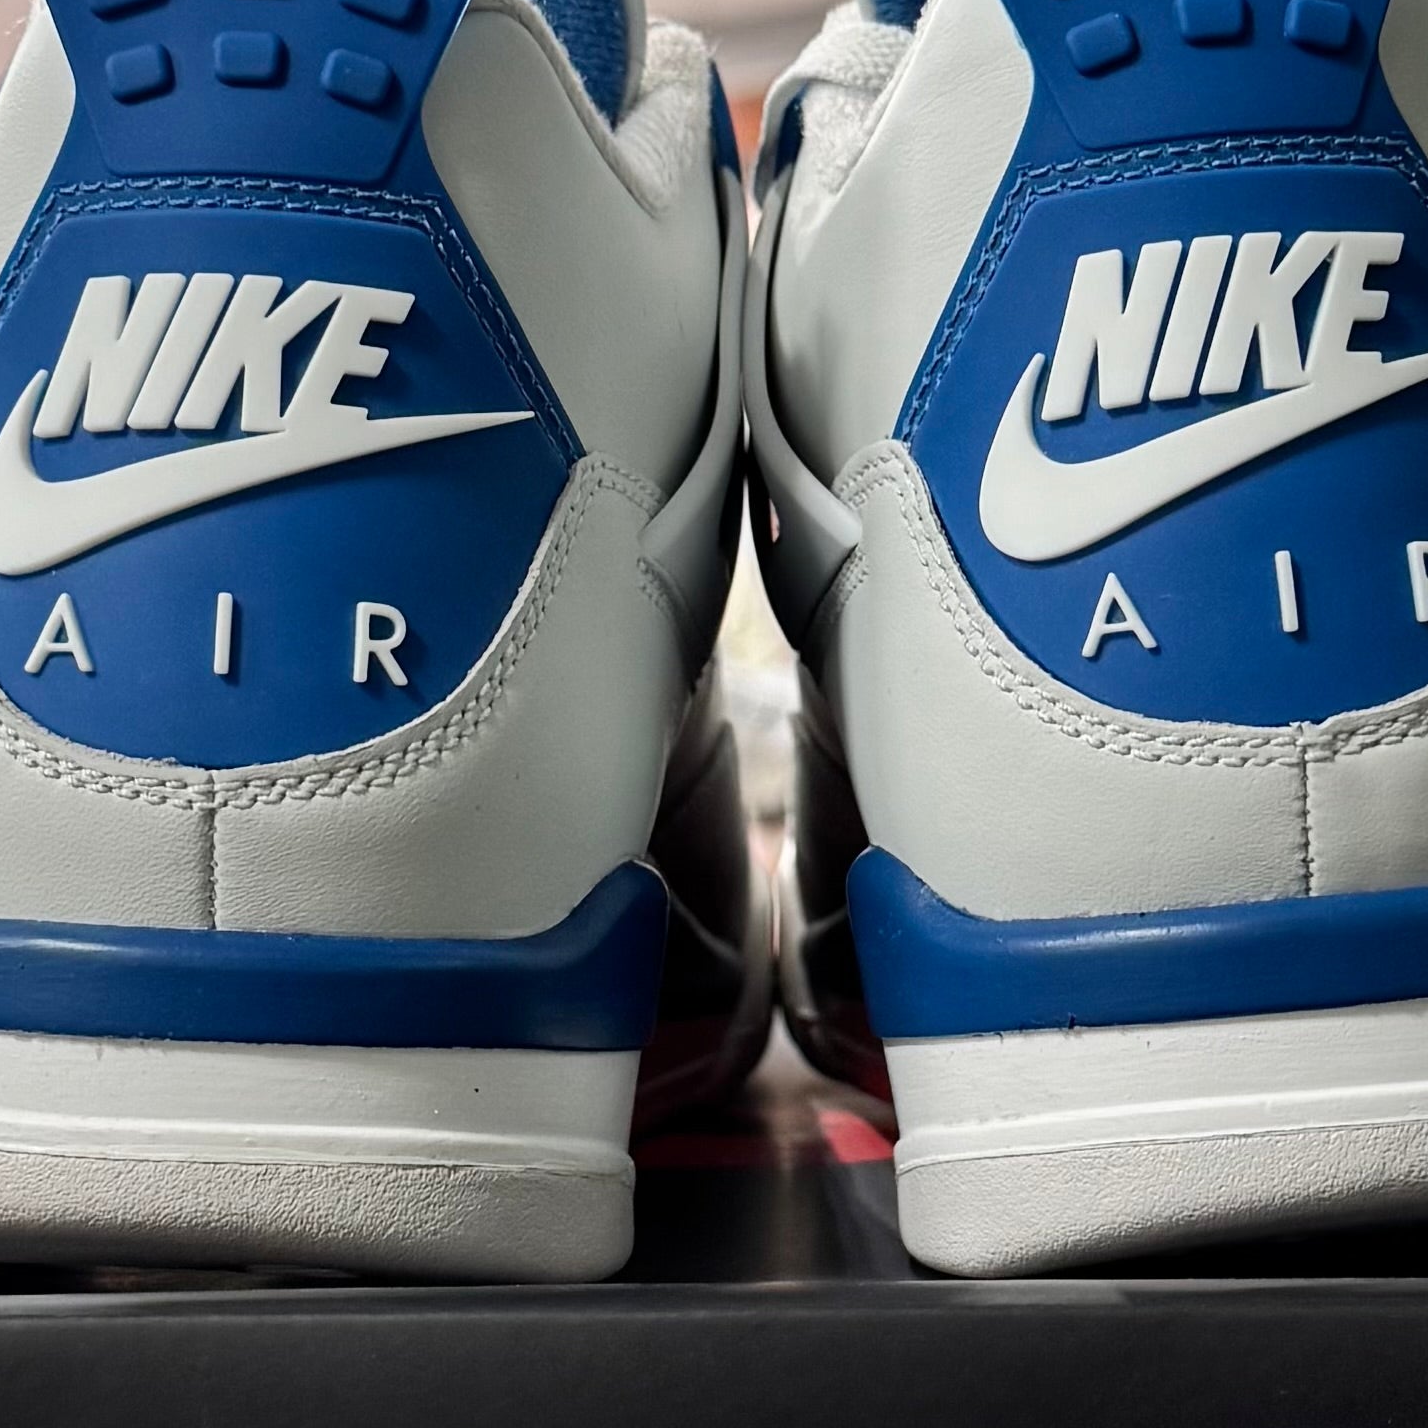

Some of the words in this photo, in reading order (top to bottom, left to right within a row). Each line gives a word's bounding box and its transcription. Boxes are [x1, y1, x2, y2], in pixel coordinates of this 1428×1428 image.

[32, 272, 416, 439] NIKE
[1041, 231, 1405, 422] NIKE
[23, 592, 409, 687] AIR
